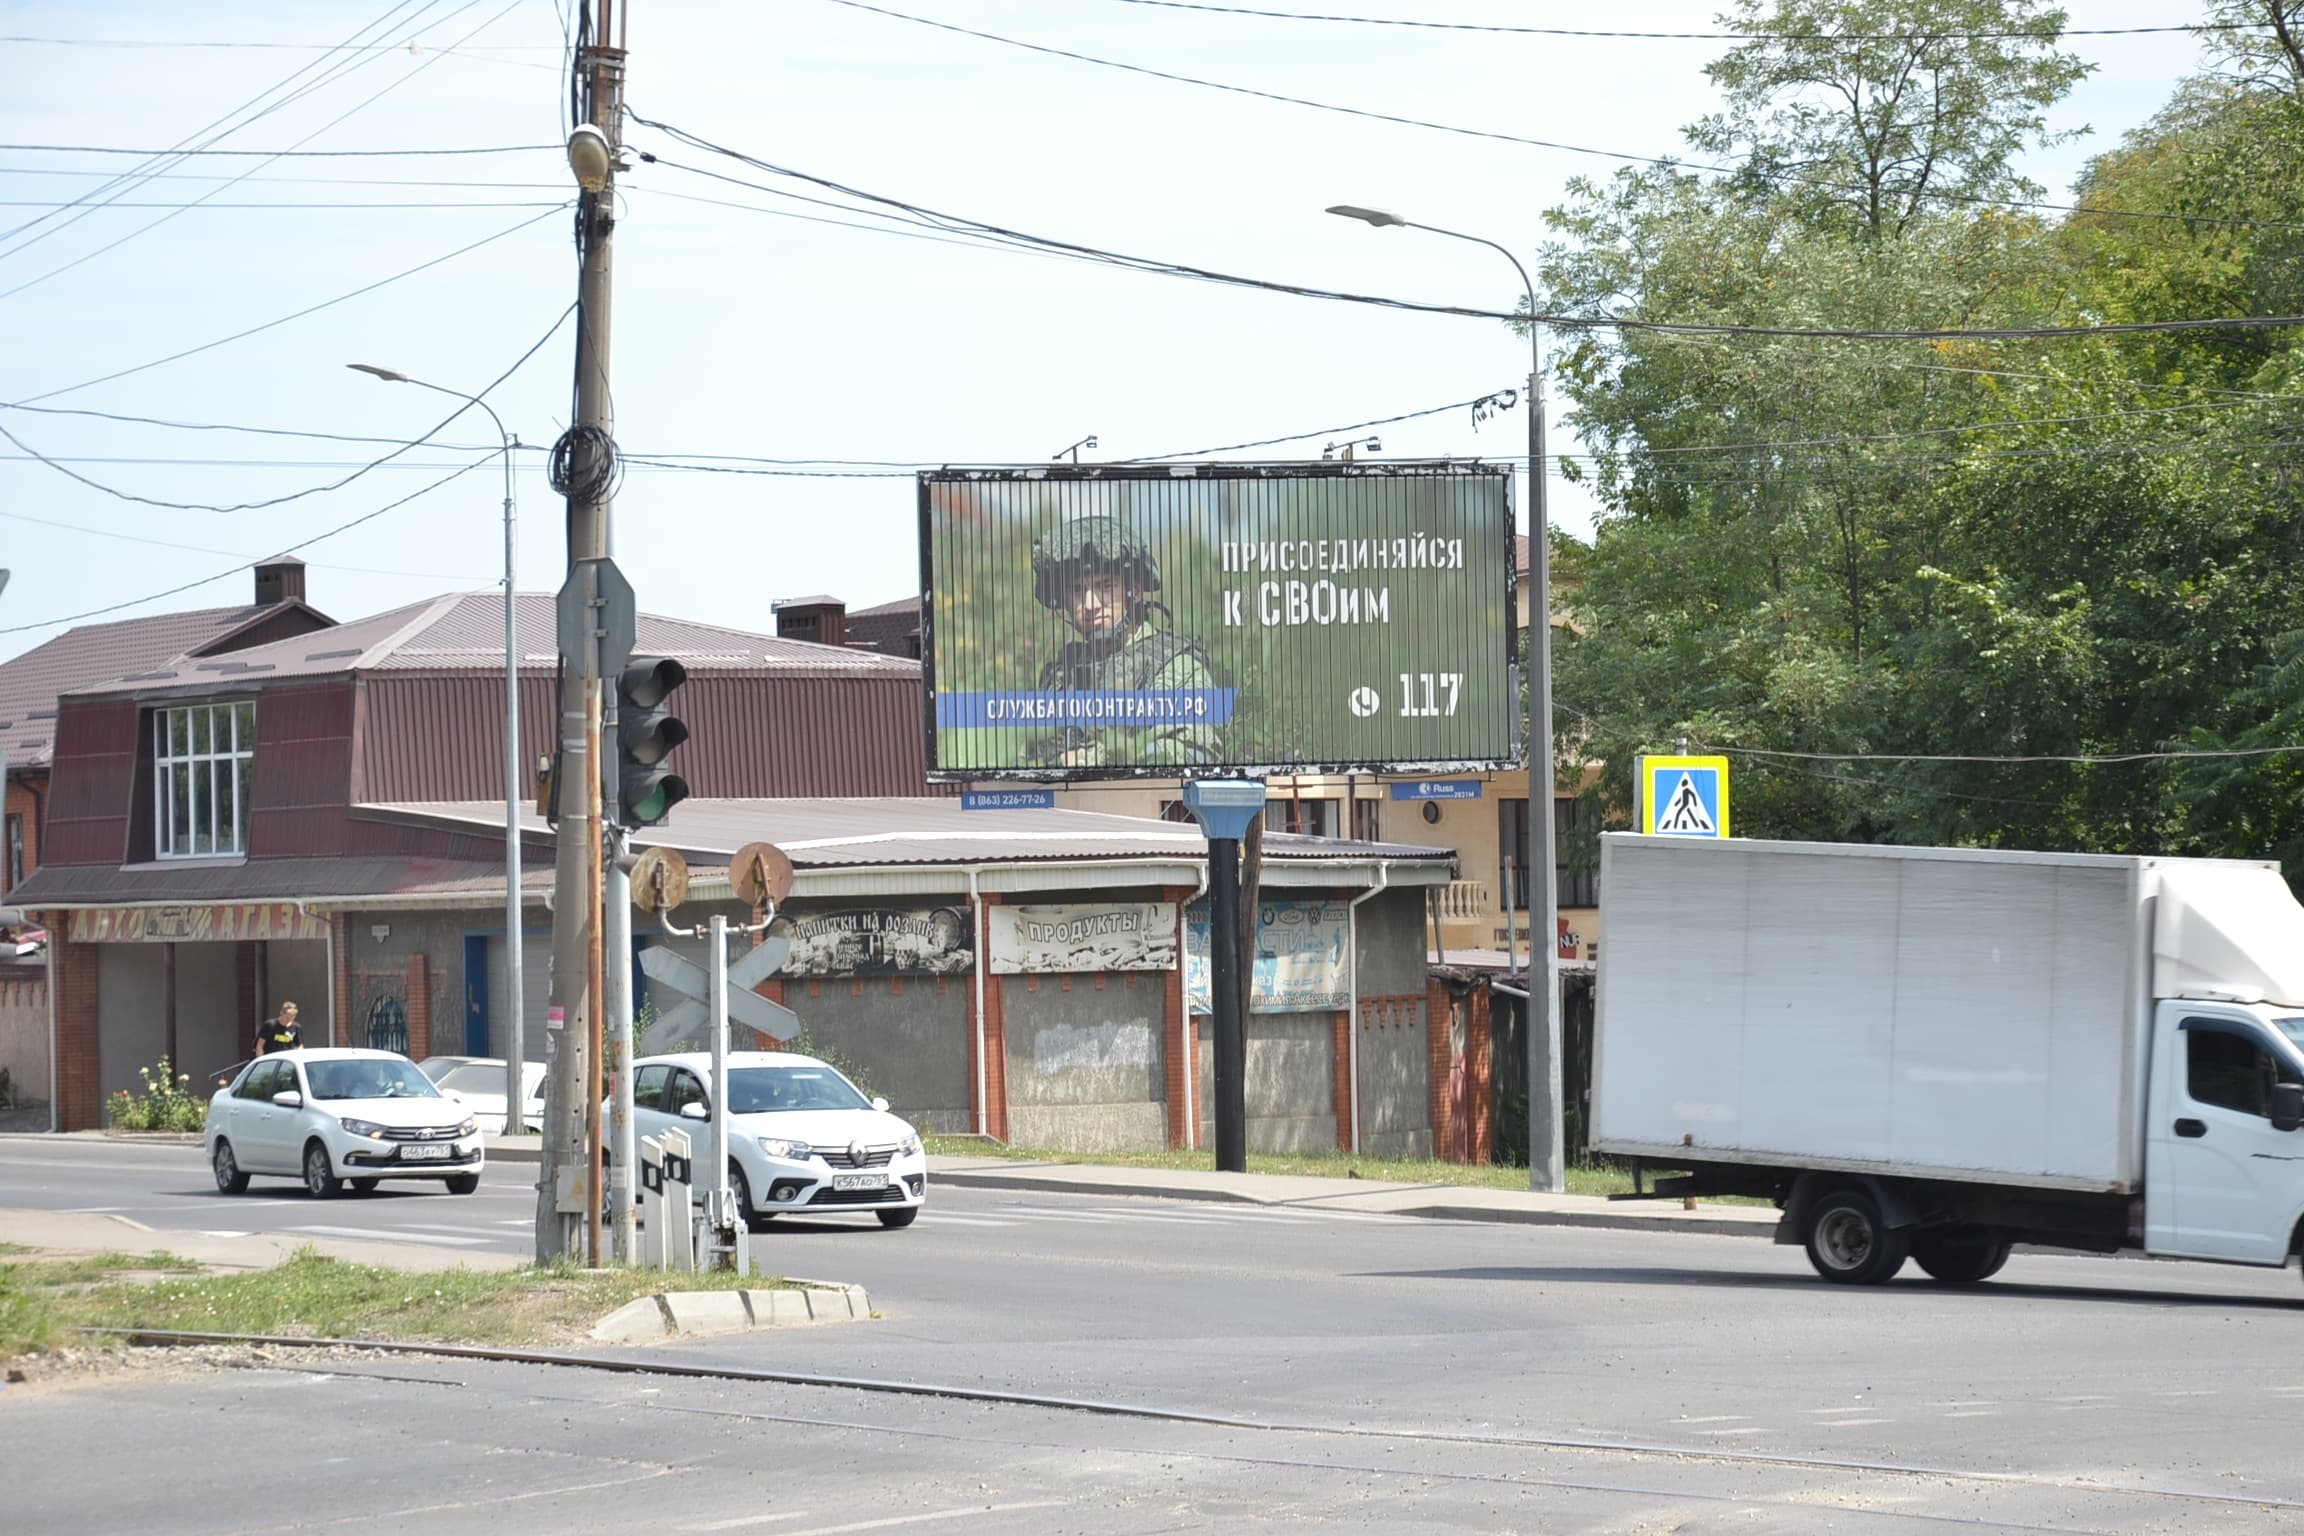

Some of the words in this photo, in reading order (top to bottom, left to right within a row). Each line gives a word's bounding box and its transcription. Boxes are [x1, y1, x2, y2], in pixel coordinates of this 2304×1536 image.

[1222, 531, 1463, 574] ПРИСОЕДИНЯЙСЯ
[986, 695, 1208, 720] СЛУЖБАПОКОНТРАКТУ.РФ
[1400, 672, 1463, 717] 117
[977, 794, 1000, 807] (863)
[1002, 793, 1046, 805] 226-77-26
[1027, 907, 1139, 945] ПРОДУКТЫ
